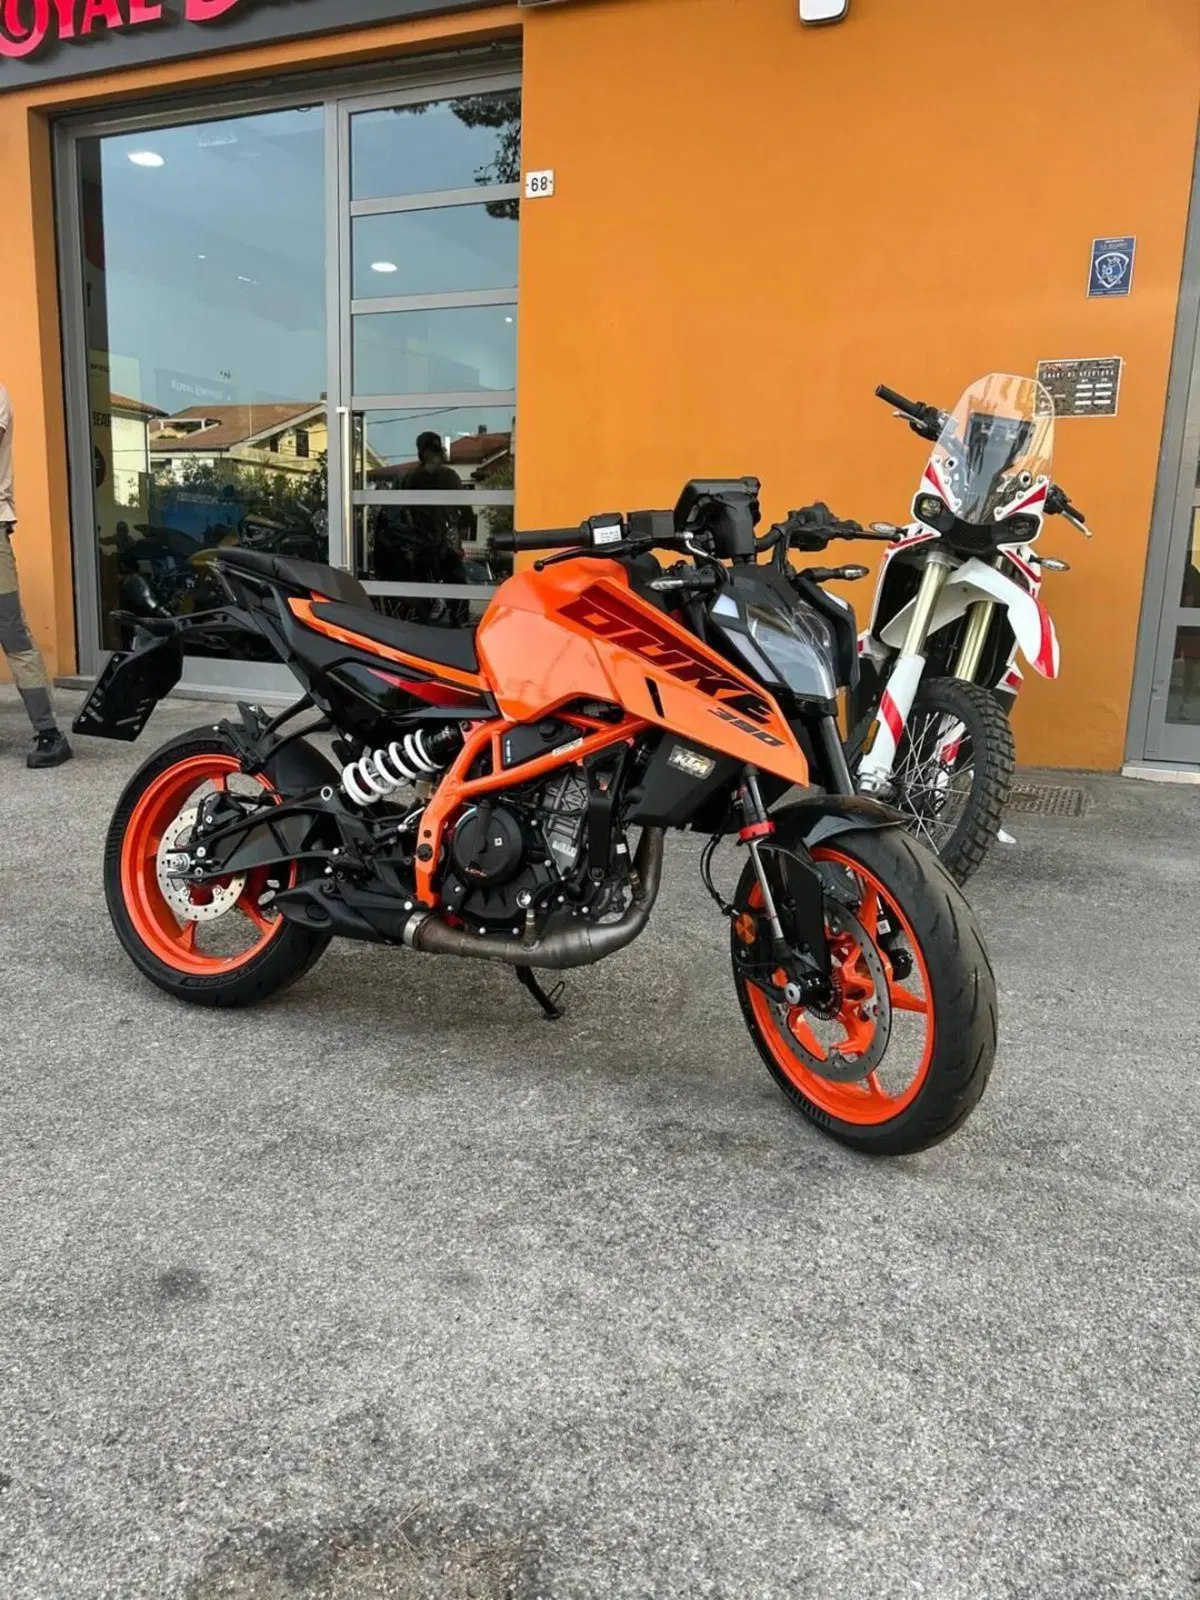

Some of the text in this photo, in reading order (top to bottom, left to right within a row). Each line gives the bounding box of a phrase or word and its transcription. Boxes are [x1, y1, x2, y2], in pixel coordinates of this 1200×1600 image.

[531, 176, 548, 192] 68
[556, 584, 773, 723] DUKE
[707, 707, 786, 747] 390
[673, 754, 708, 774] KTM
